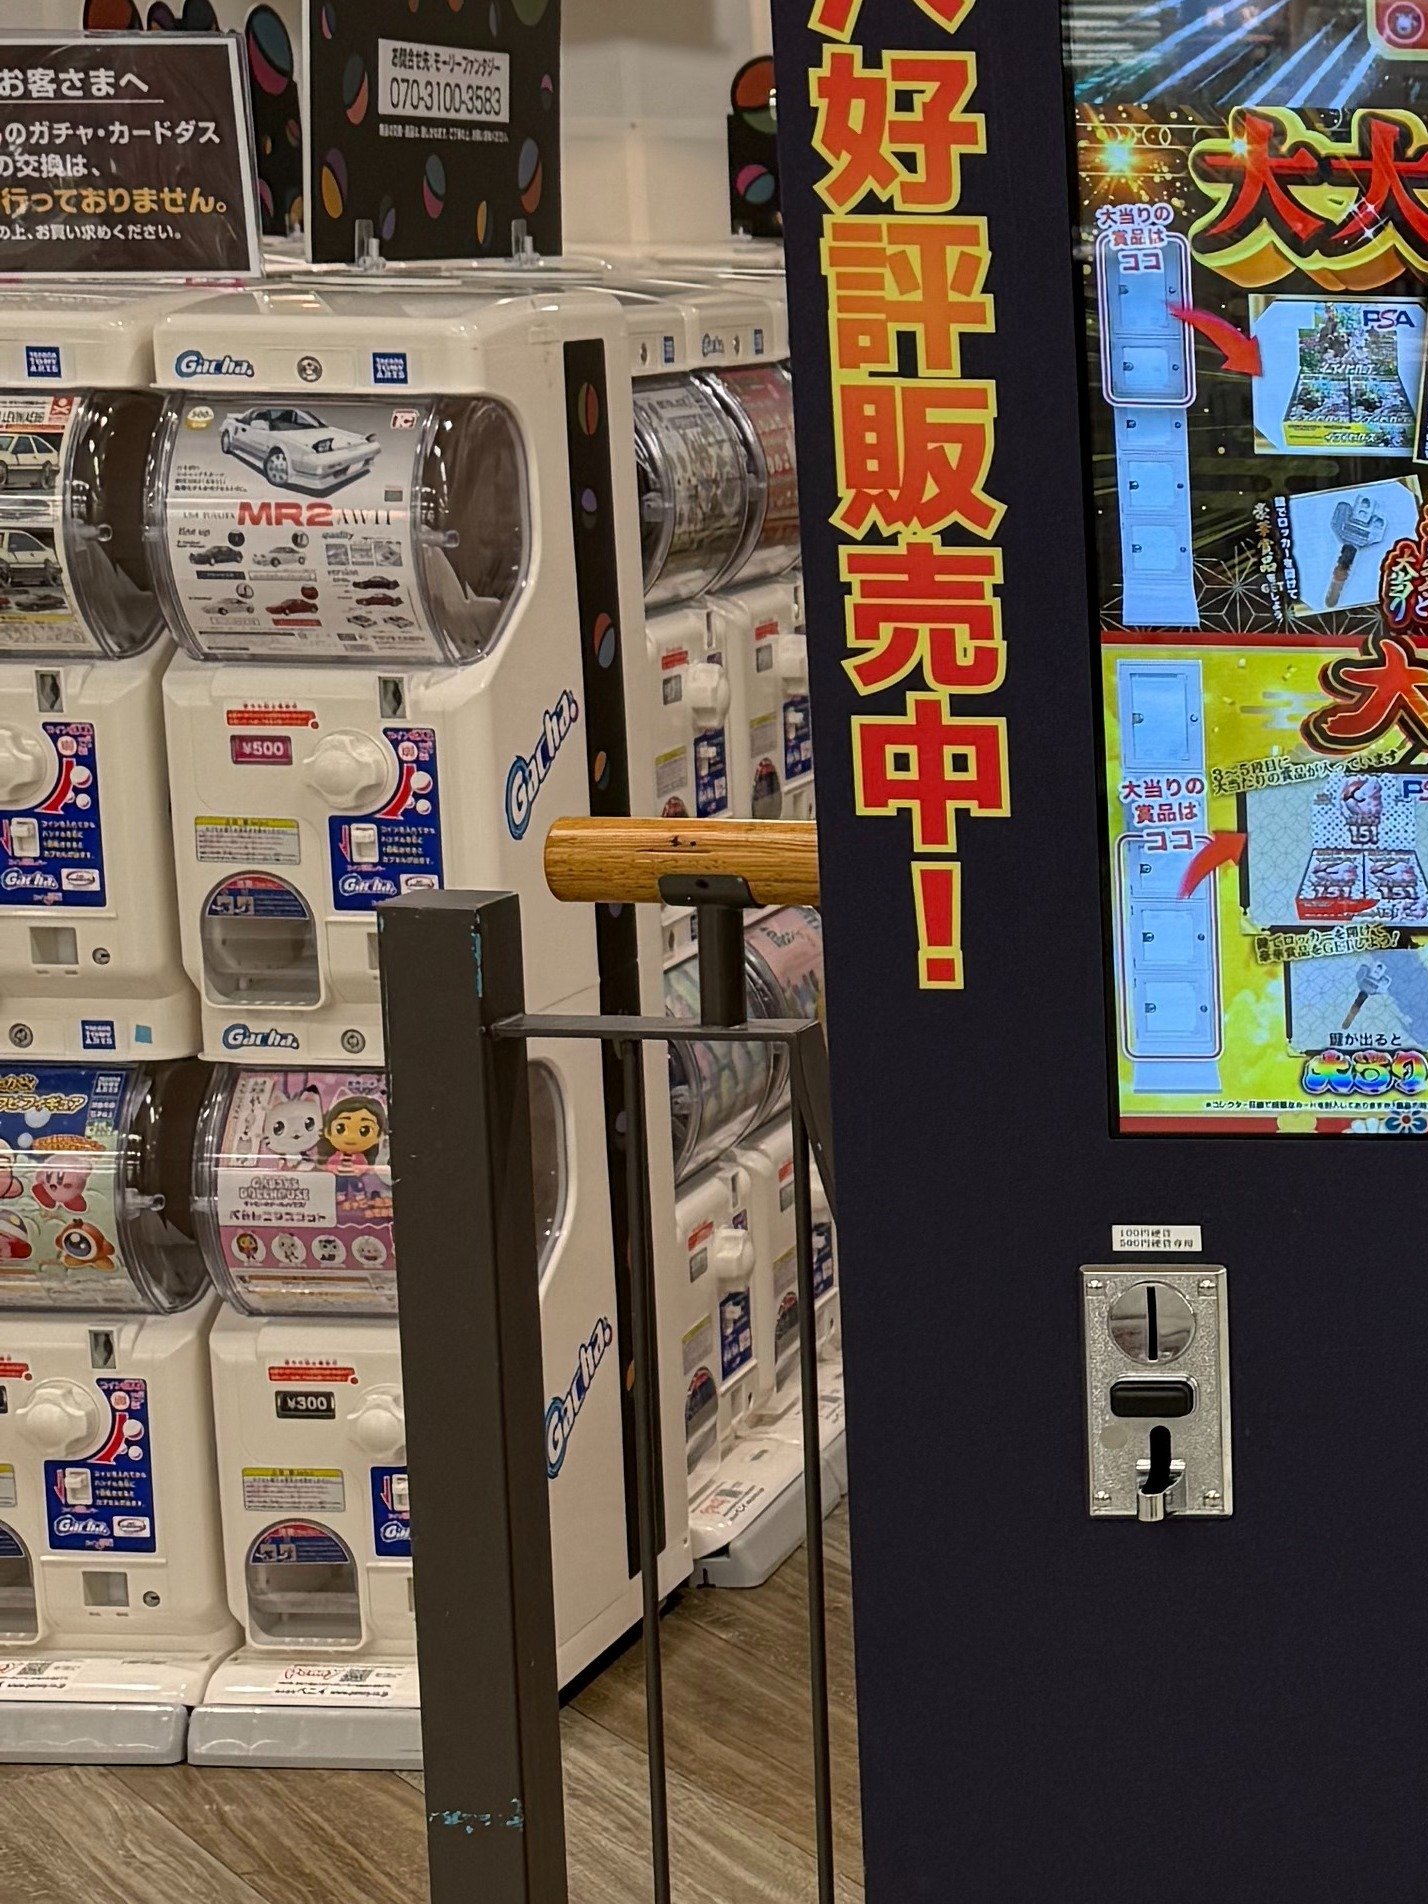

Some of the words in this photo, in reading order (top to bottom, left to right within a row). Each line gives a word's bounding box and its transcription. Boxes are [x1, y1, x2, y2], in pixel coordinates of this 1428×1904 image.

[389, 76, 501, 116] 070-3100-3583
[5, 120, 220, 146] のガチャ・カードダス
[0, 186, 227, 218] 行っておりません。
[1100, 205, 1172, 227] 大当りの
[1110, 226, 1166, 247] 賞品は
[1119, 248, 1163, 273] ココ
[1362, 309, 1416, 329] PSA
[237, 500, 335, 527] MR2
[1121, 777, 1205, 800] 大当りの
[1134, 800, 1198, 825] 賞品は
[1144, 829, 1194, 853] ココ
